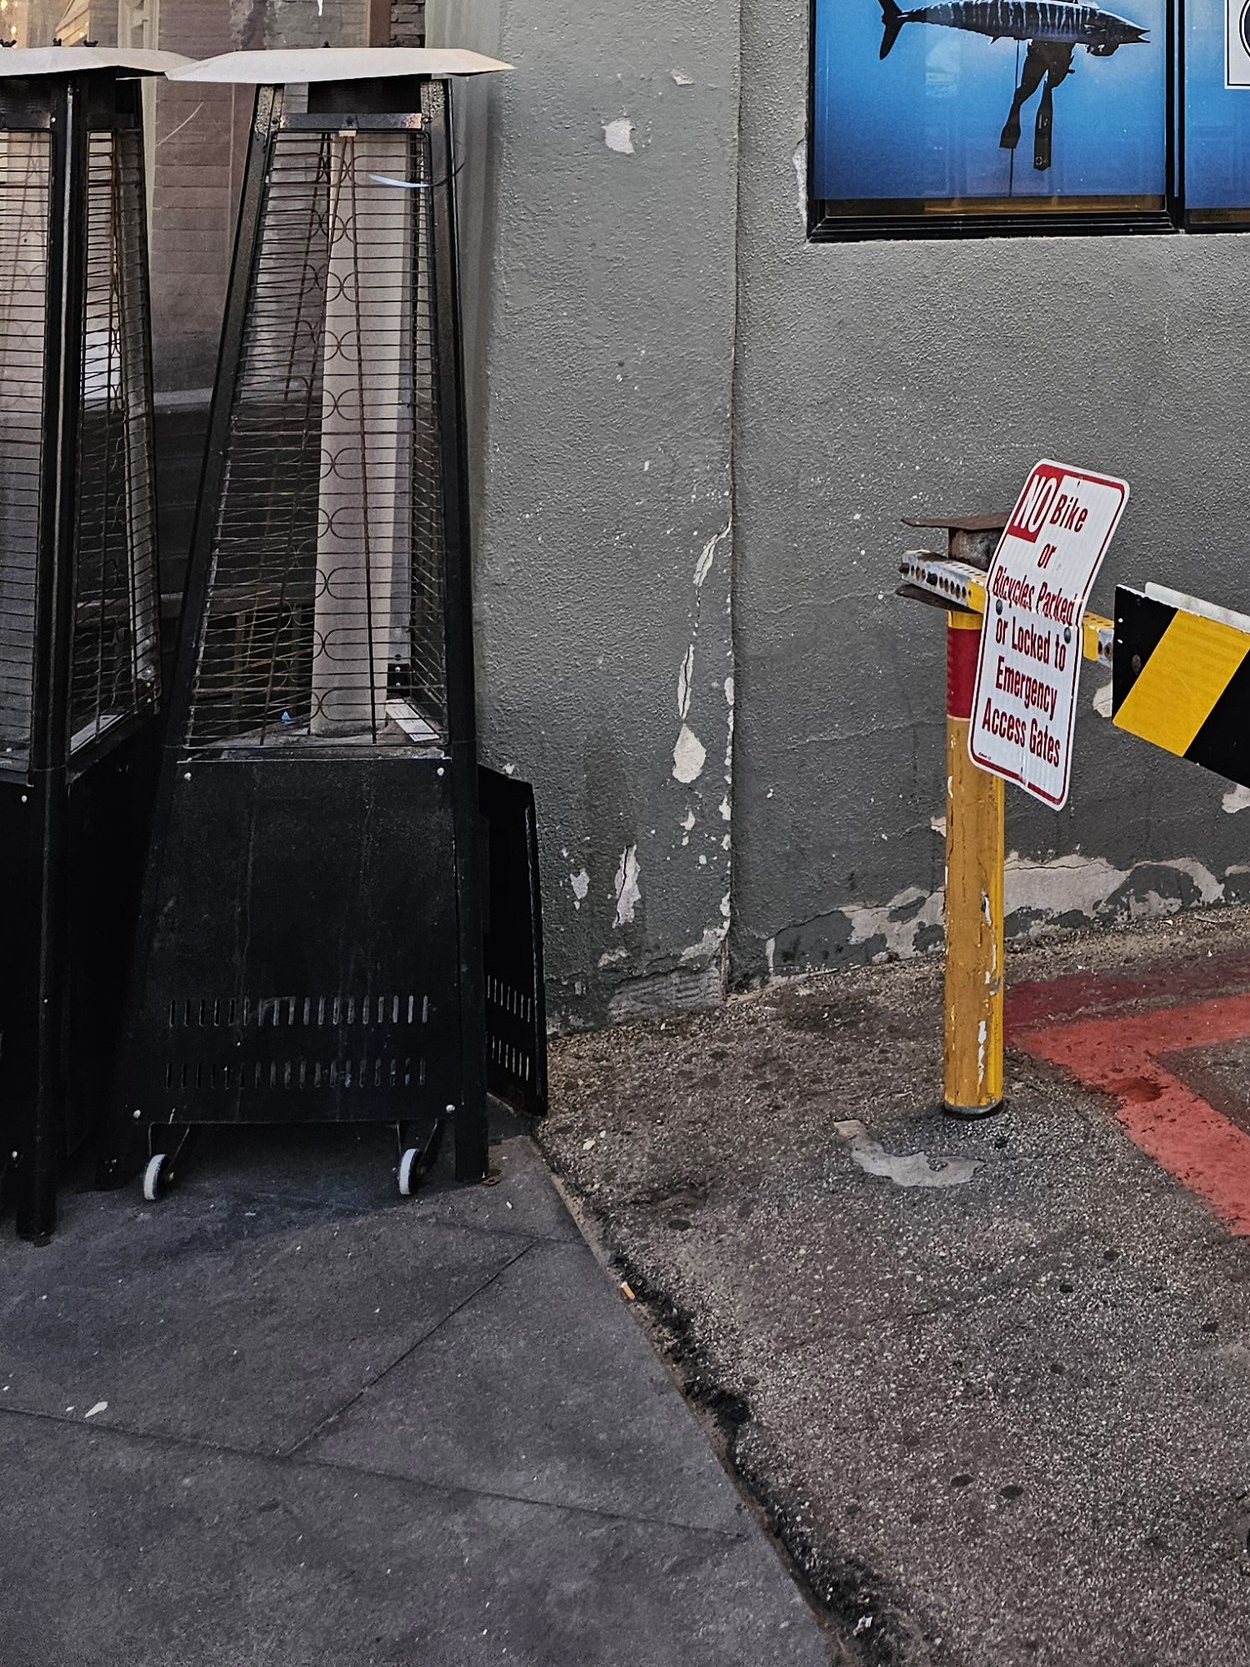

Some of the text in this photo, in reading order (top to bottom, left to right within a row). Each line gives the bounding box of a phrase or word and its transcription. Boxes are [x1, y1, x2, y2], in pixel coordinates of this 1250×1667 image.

[1013, 474, 1089, 533] NO Bike
[1037, 543, 1058, 569] or
[992, 564, 1078, 627] Bicycles Parked
[995, 615, 1067, 672] or Locked to
[995, 655, 1058, 721] Emergency
[981, 697, 1061, 768] Access Gates
